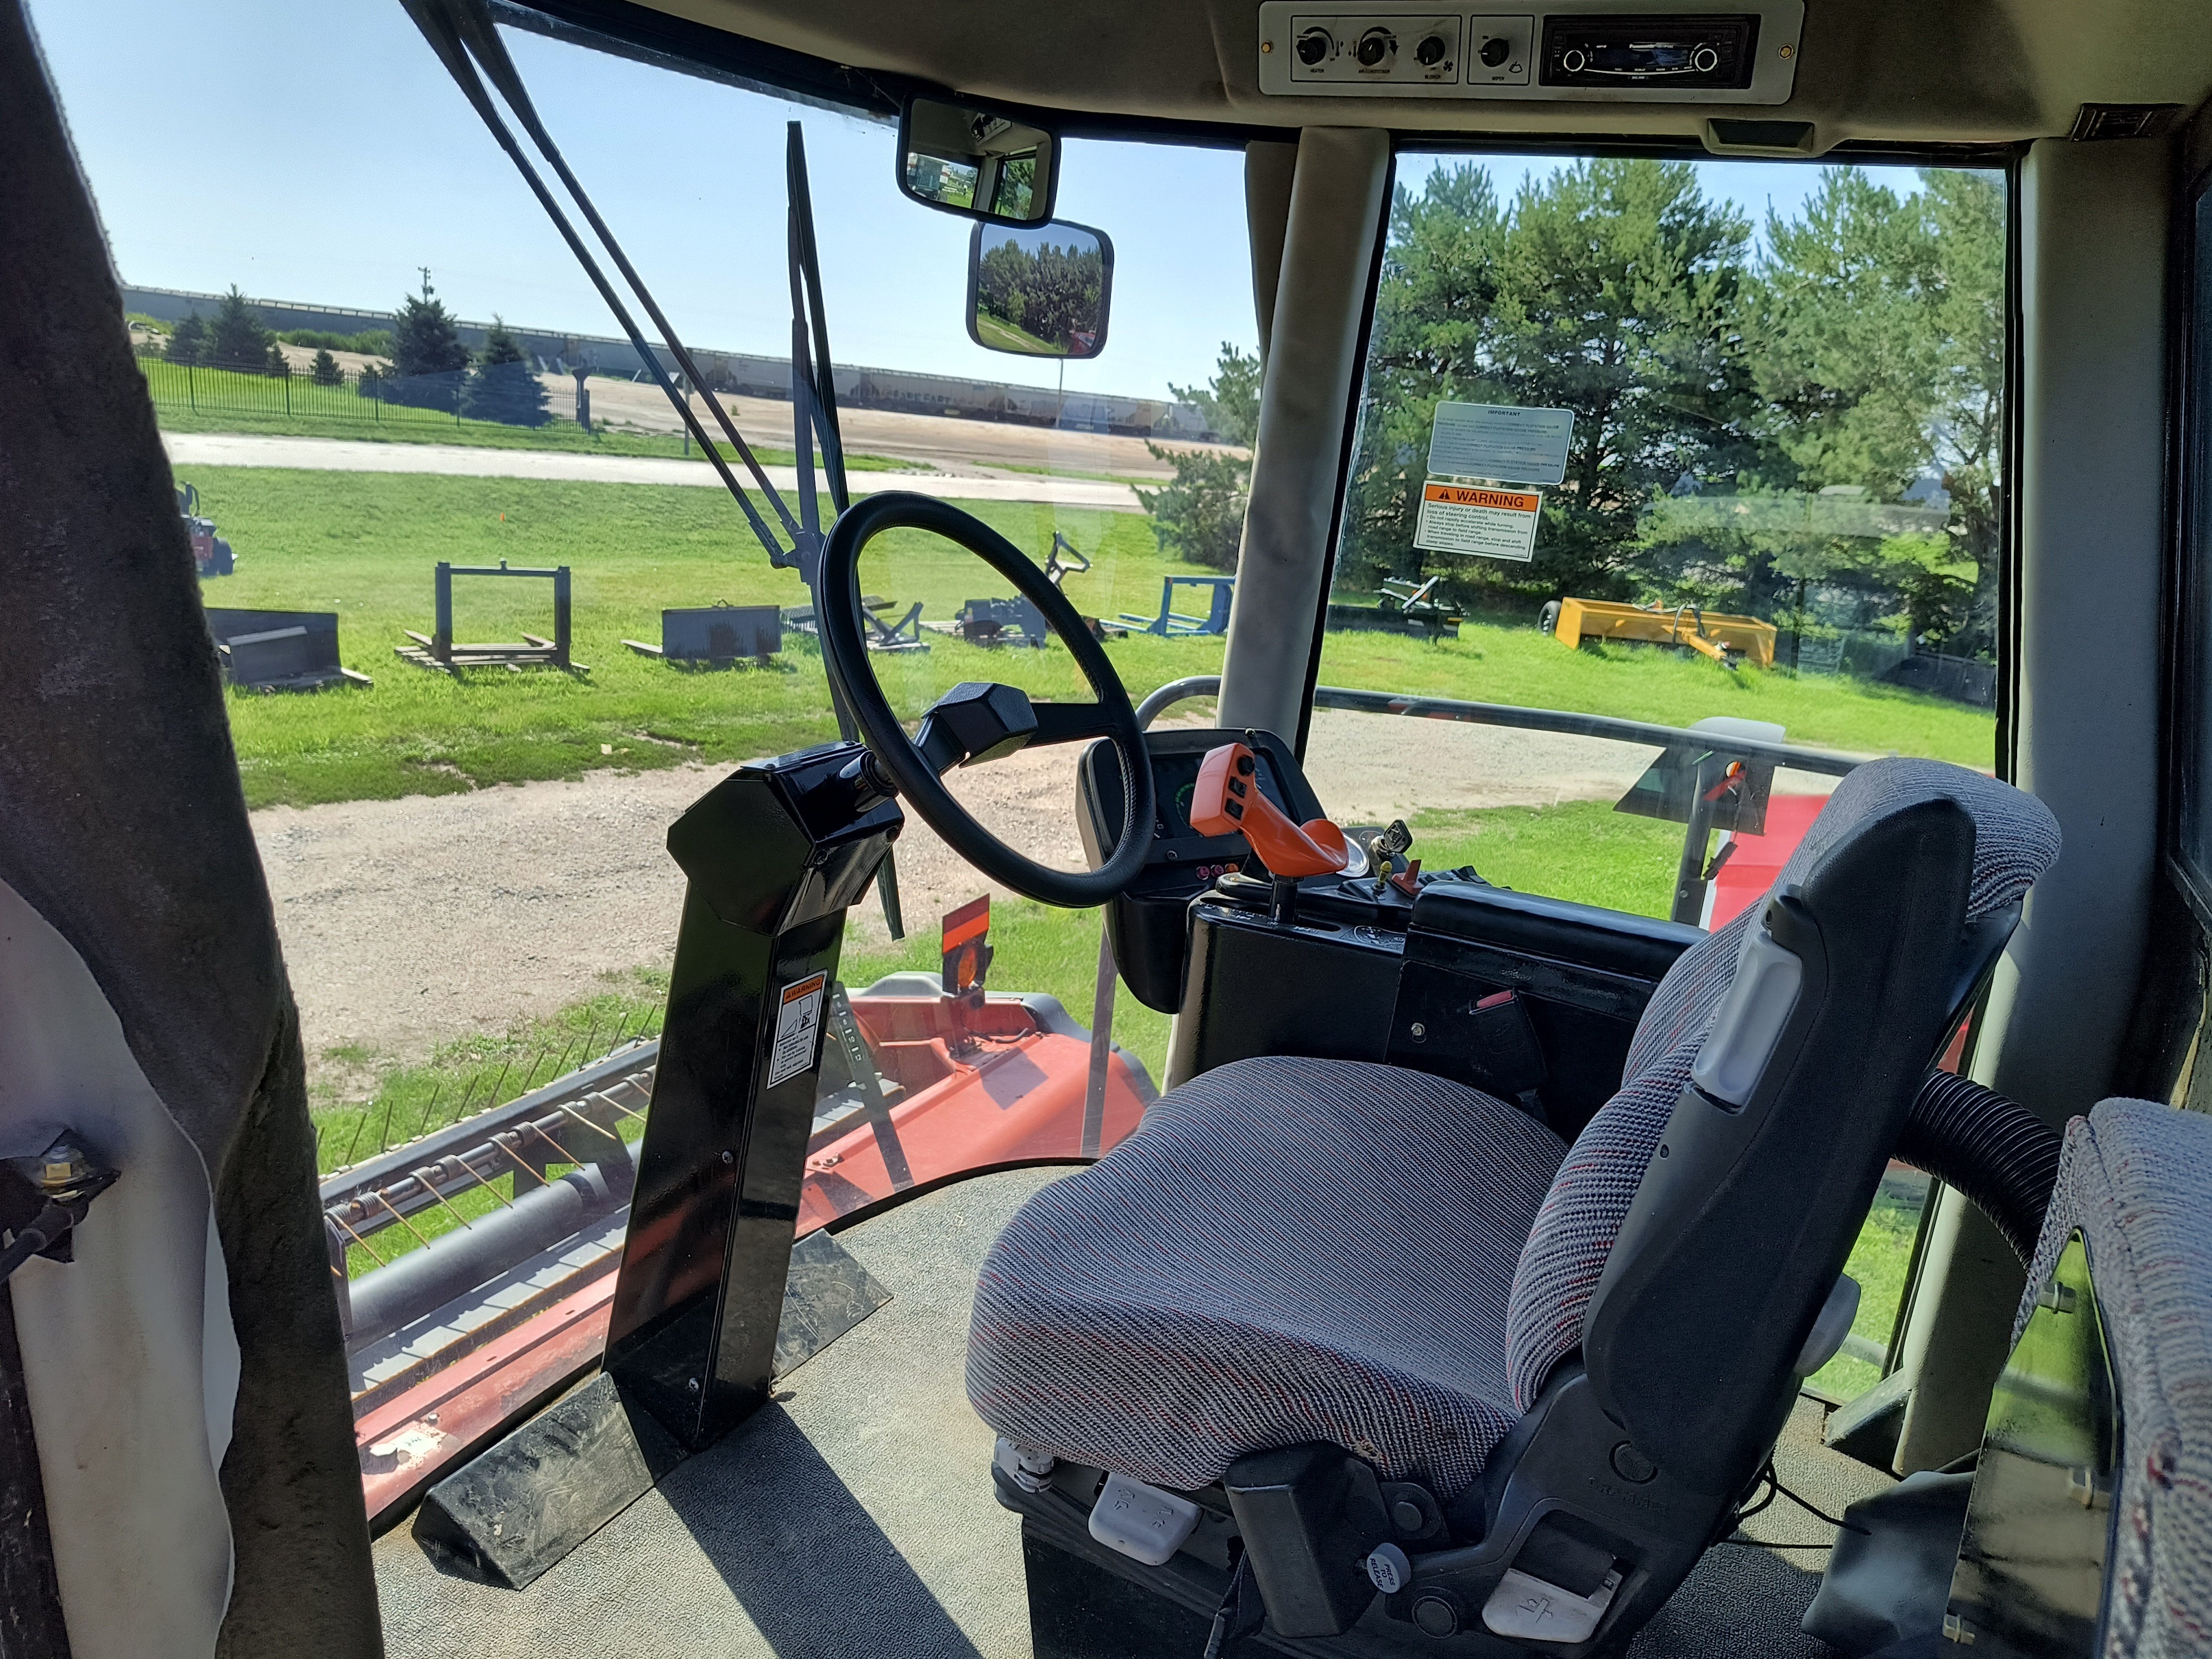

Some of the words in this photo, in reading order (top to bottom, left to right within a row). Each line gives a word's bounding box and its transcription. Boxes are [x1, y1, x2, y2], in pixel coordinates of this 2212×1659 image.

[1457, 491, 1523, 507] WARNING
[791, 979, 820, 995] WARNING
[1370, 1558, 1384, 1588] RELEASE
[1384, 1563, 1395, 1586] PRESS
